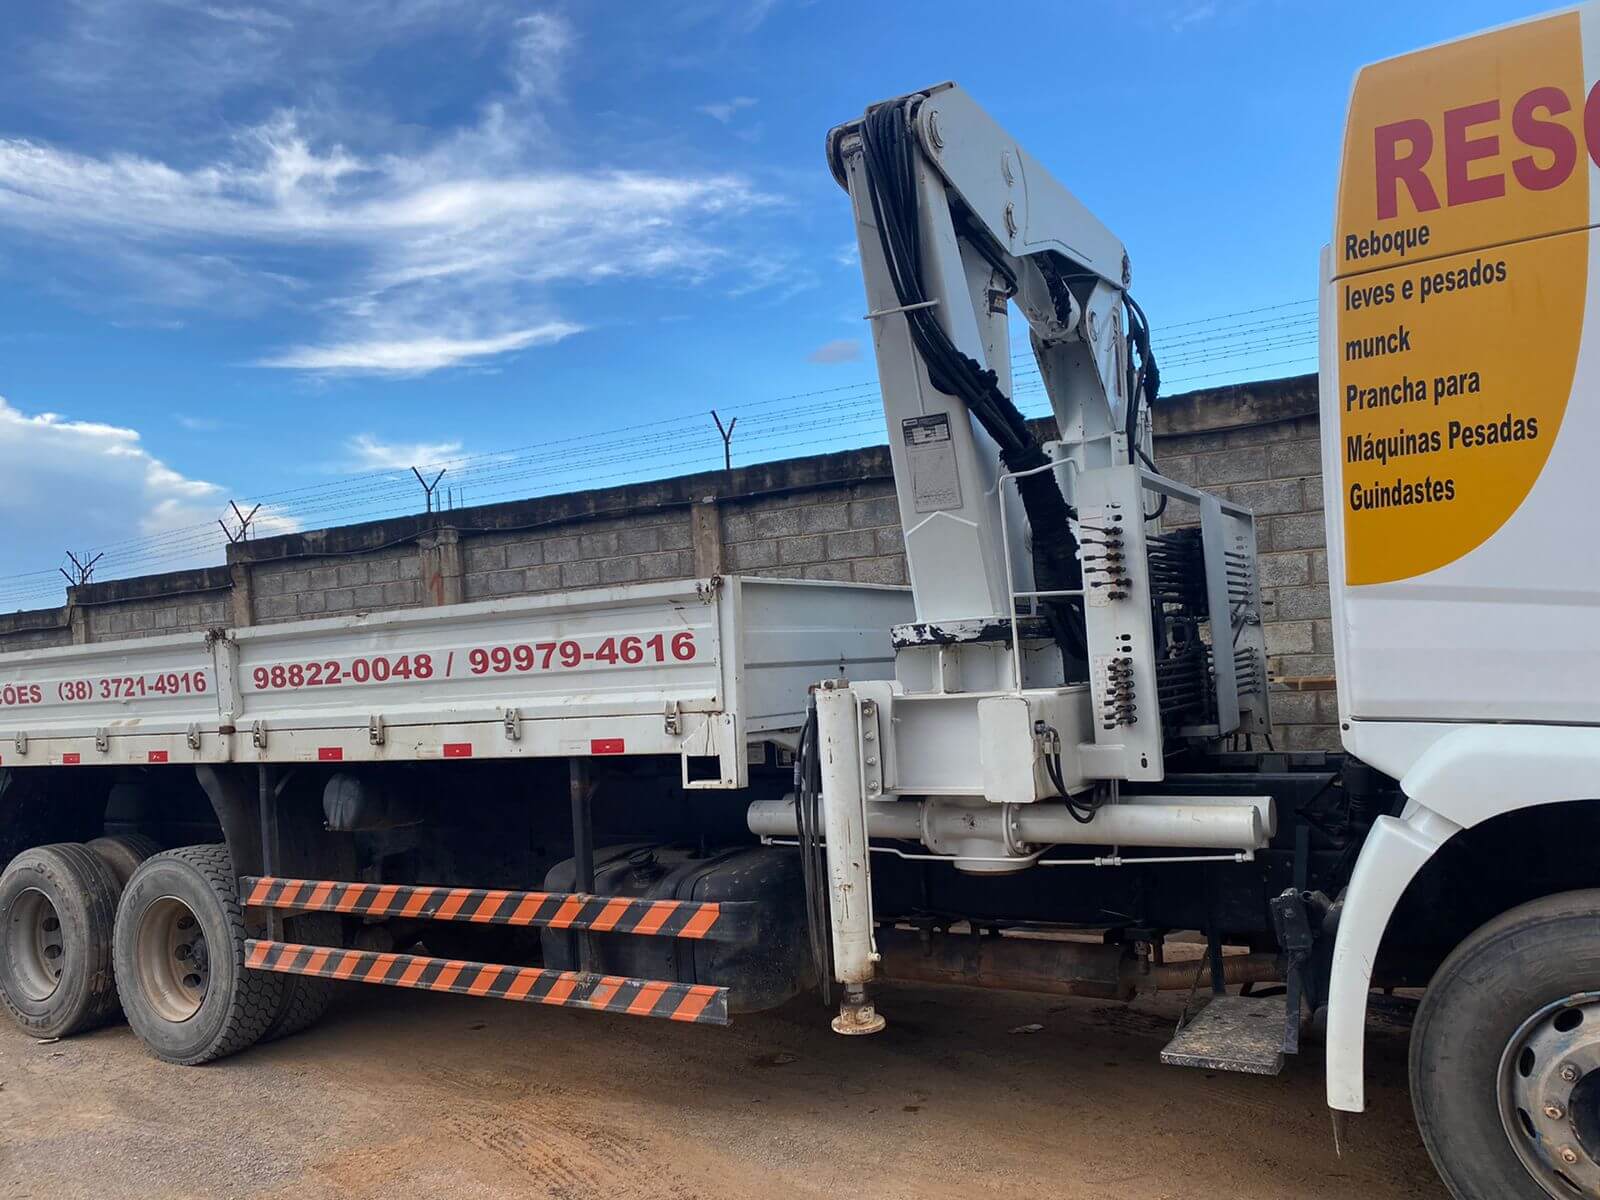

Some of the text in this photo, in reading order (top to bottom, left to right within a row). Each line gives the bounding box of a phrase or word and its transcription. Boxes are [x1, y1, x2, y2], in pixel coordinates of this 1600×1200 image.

[1374, 79, 1600, 221] RES
[1345, 225, 1430, 261] Reboque
[1345, 259, 1507, 311] leves e pesados
[1345, 325, 1411, 361] munck
[1346, 371, 1480, 412] Prancha para
[1346, 413, 1538, 465] Máquinas Pesadas
[1350, 476, 1455, 511] Guindastes
[253, 654, 433, 690] 98822-0048
[469, 632, 696, 675] 99979-4616
[0, 671, 206, 706] ÕES (38) 3721-4916
